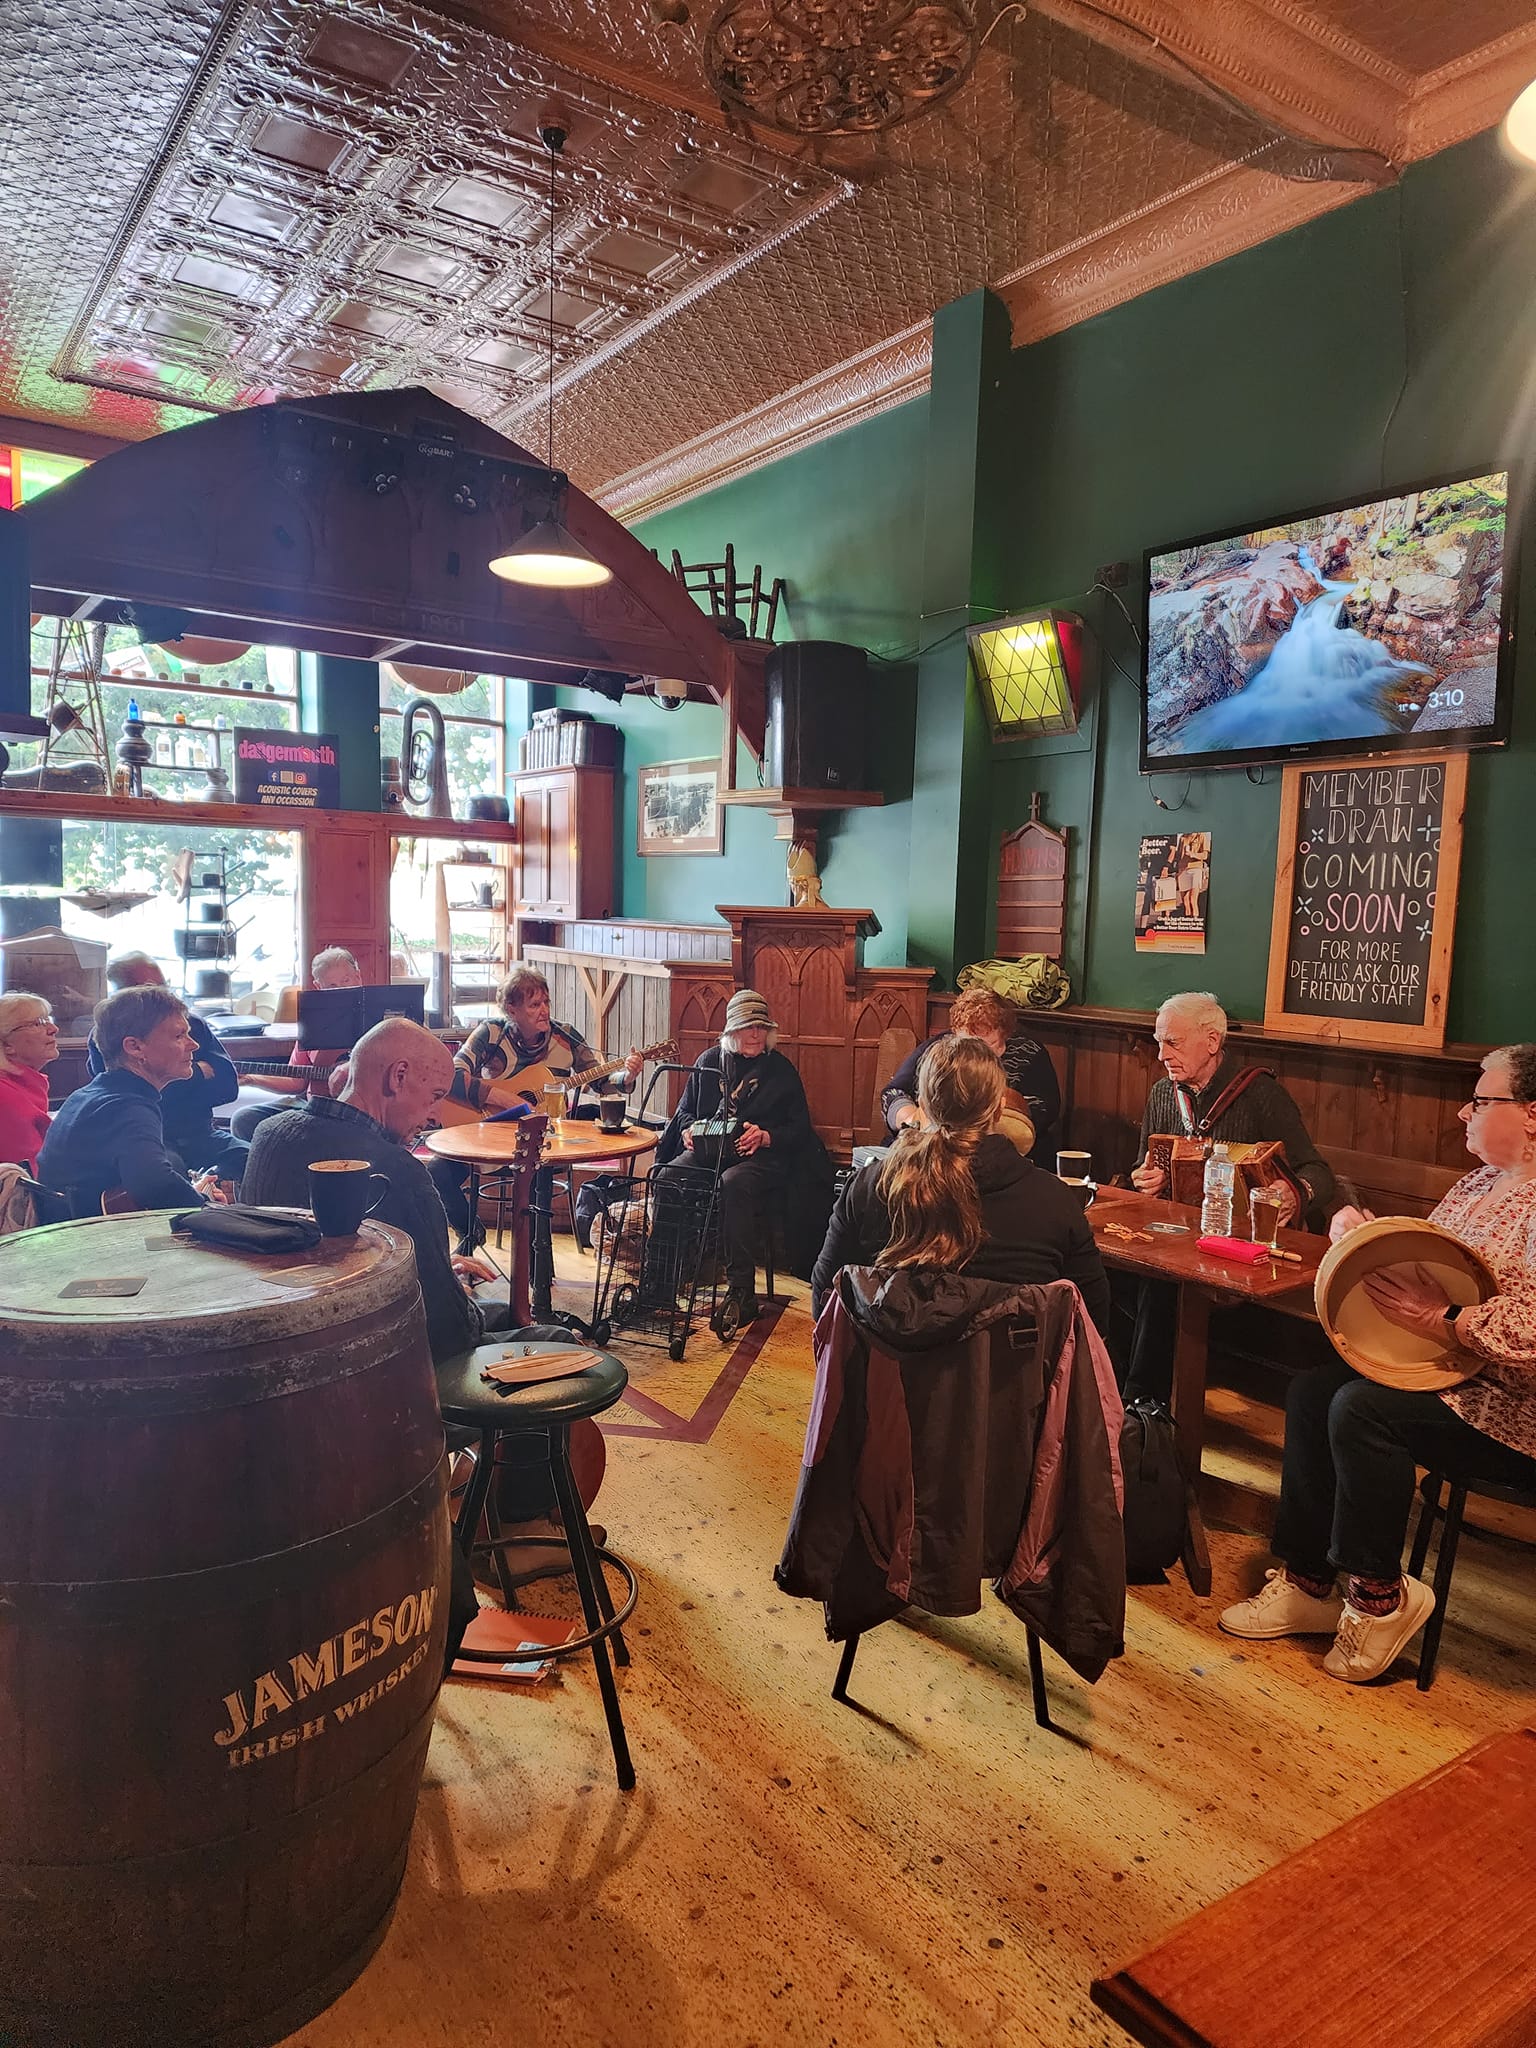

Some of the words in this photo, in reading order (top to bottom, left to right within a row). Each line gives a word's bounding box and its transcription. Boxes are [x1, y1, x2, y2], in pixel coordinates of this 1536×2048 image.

[1428, 688, 1464, 709] 3:10
[257, 784, 291, 794] ACOUSTIC
[291, 786, 318, 796] COVERS
[260, 795, 275, 804] ANY
[275, 796, 315, 806] OCCASSION
[1304, 766, 1442, 809] MEMBER
[1327, 807, 1414, 845] DRAW
[1141, 846, 1162, 855] Beer.
[1142, 839, 1168, 847] Better
[1303, 852, 1433, 891] COMING
[1325, 892, 1406, 934] SOON
[1320, 940, 1350, 960] FOR
[1356, 941, 1402, 963] MORE
[1290, 960, 1349, 982] DETAILS
[1352, 963, 1383, 983] ASK
[1389, 964, 1420, 986] OUR
[1300, 980, 1367, 1003] FRIENDLY
[1371, 984, 1419, 1006] STAFF
[213, 1584, 440, 1747] JAMESON
[227, 1714, 327, 1770] IRISH
[333, 1635, 432, 1725] WHISKEY
